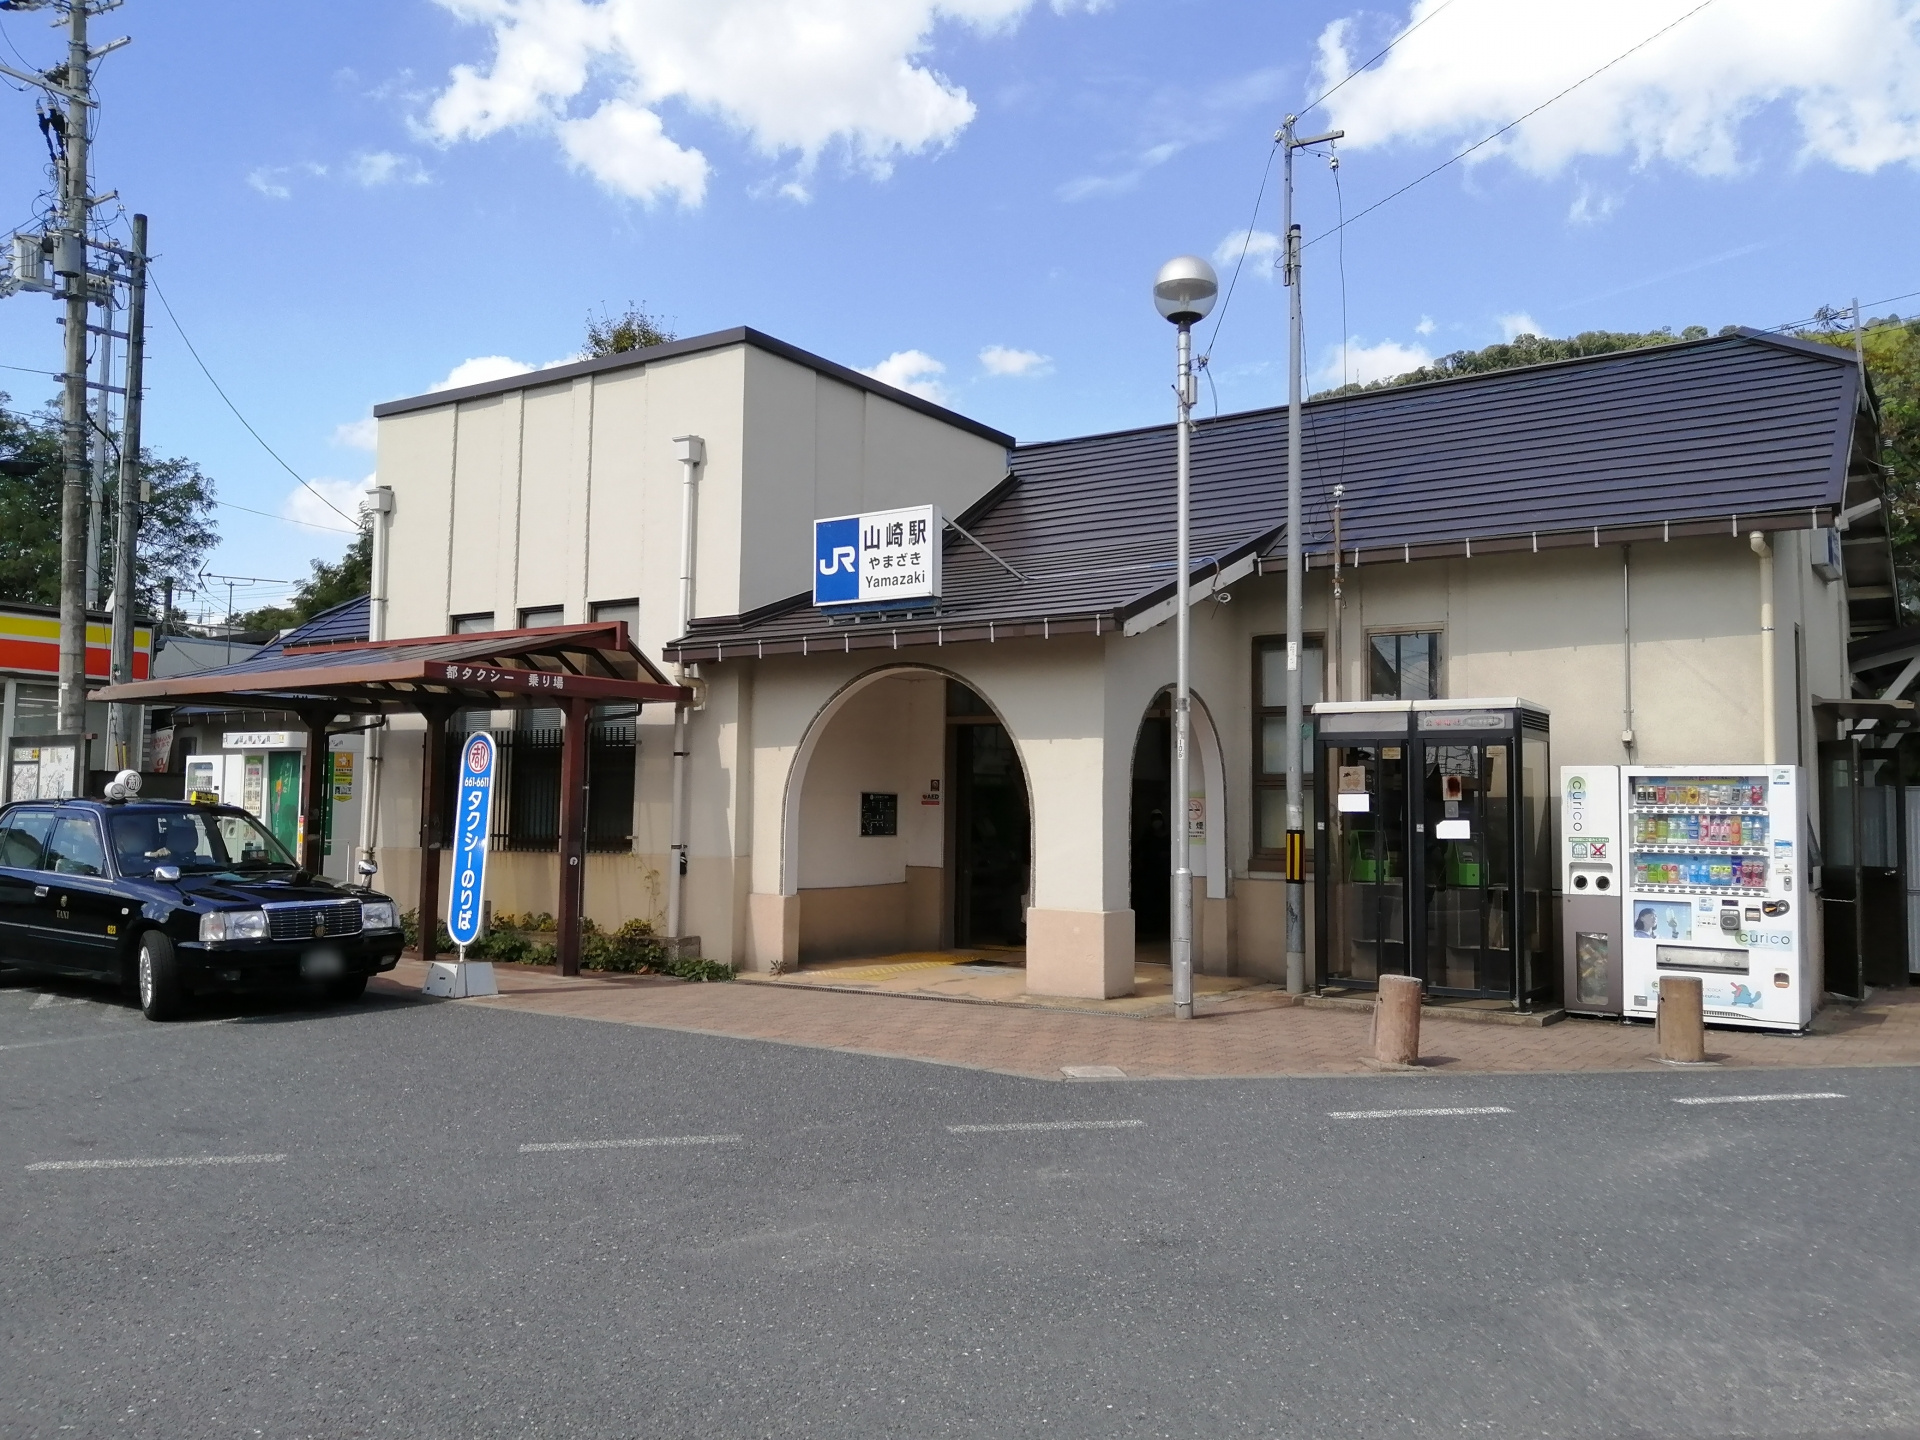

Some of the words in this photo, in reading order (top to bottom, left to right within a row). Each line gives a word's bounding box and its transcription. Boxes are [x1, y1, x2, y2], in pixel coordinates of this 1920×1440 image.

[864, 519, 926, 551] 山崎駅
[820, 546, 855, 575] JR
[869, 552, 921, 570] やまざき
[865, 570, 925, 588] Yamazaki
[446, 665, 514, 682] 都タクシー
[528, 673, 564, 689] 乗り場
[465, 777, 489, 787] 661-6611
[1573, 780, 1584, 832] curico
[457, 791, 483, 930] タクシーのりば
[56, 910, 70, 919] TAXI
[1739, 932, 1790, 945] curico
